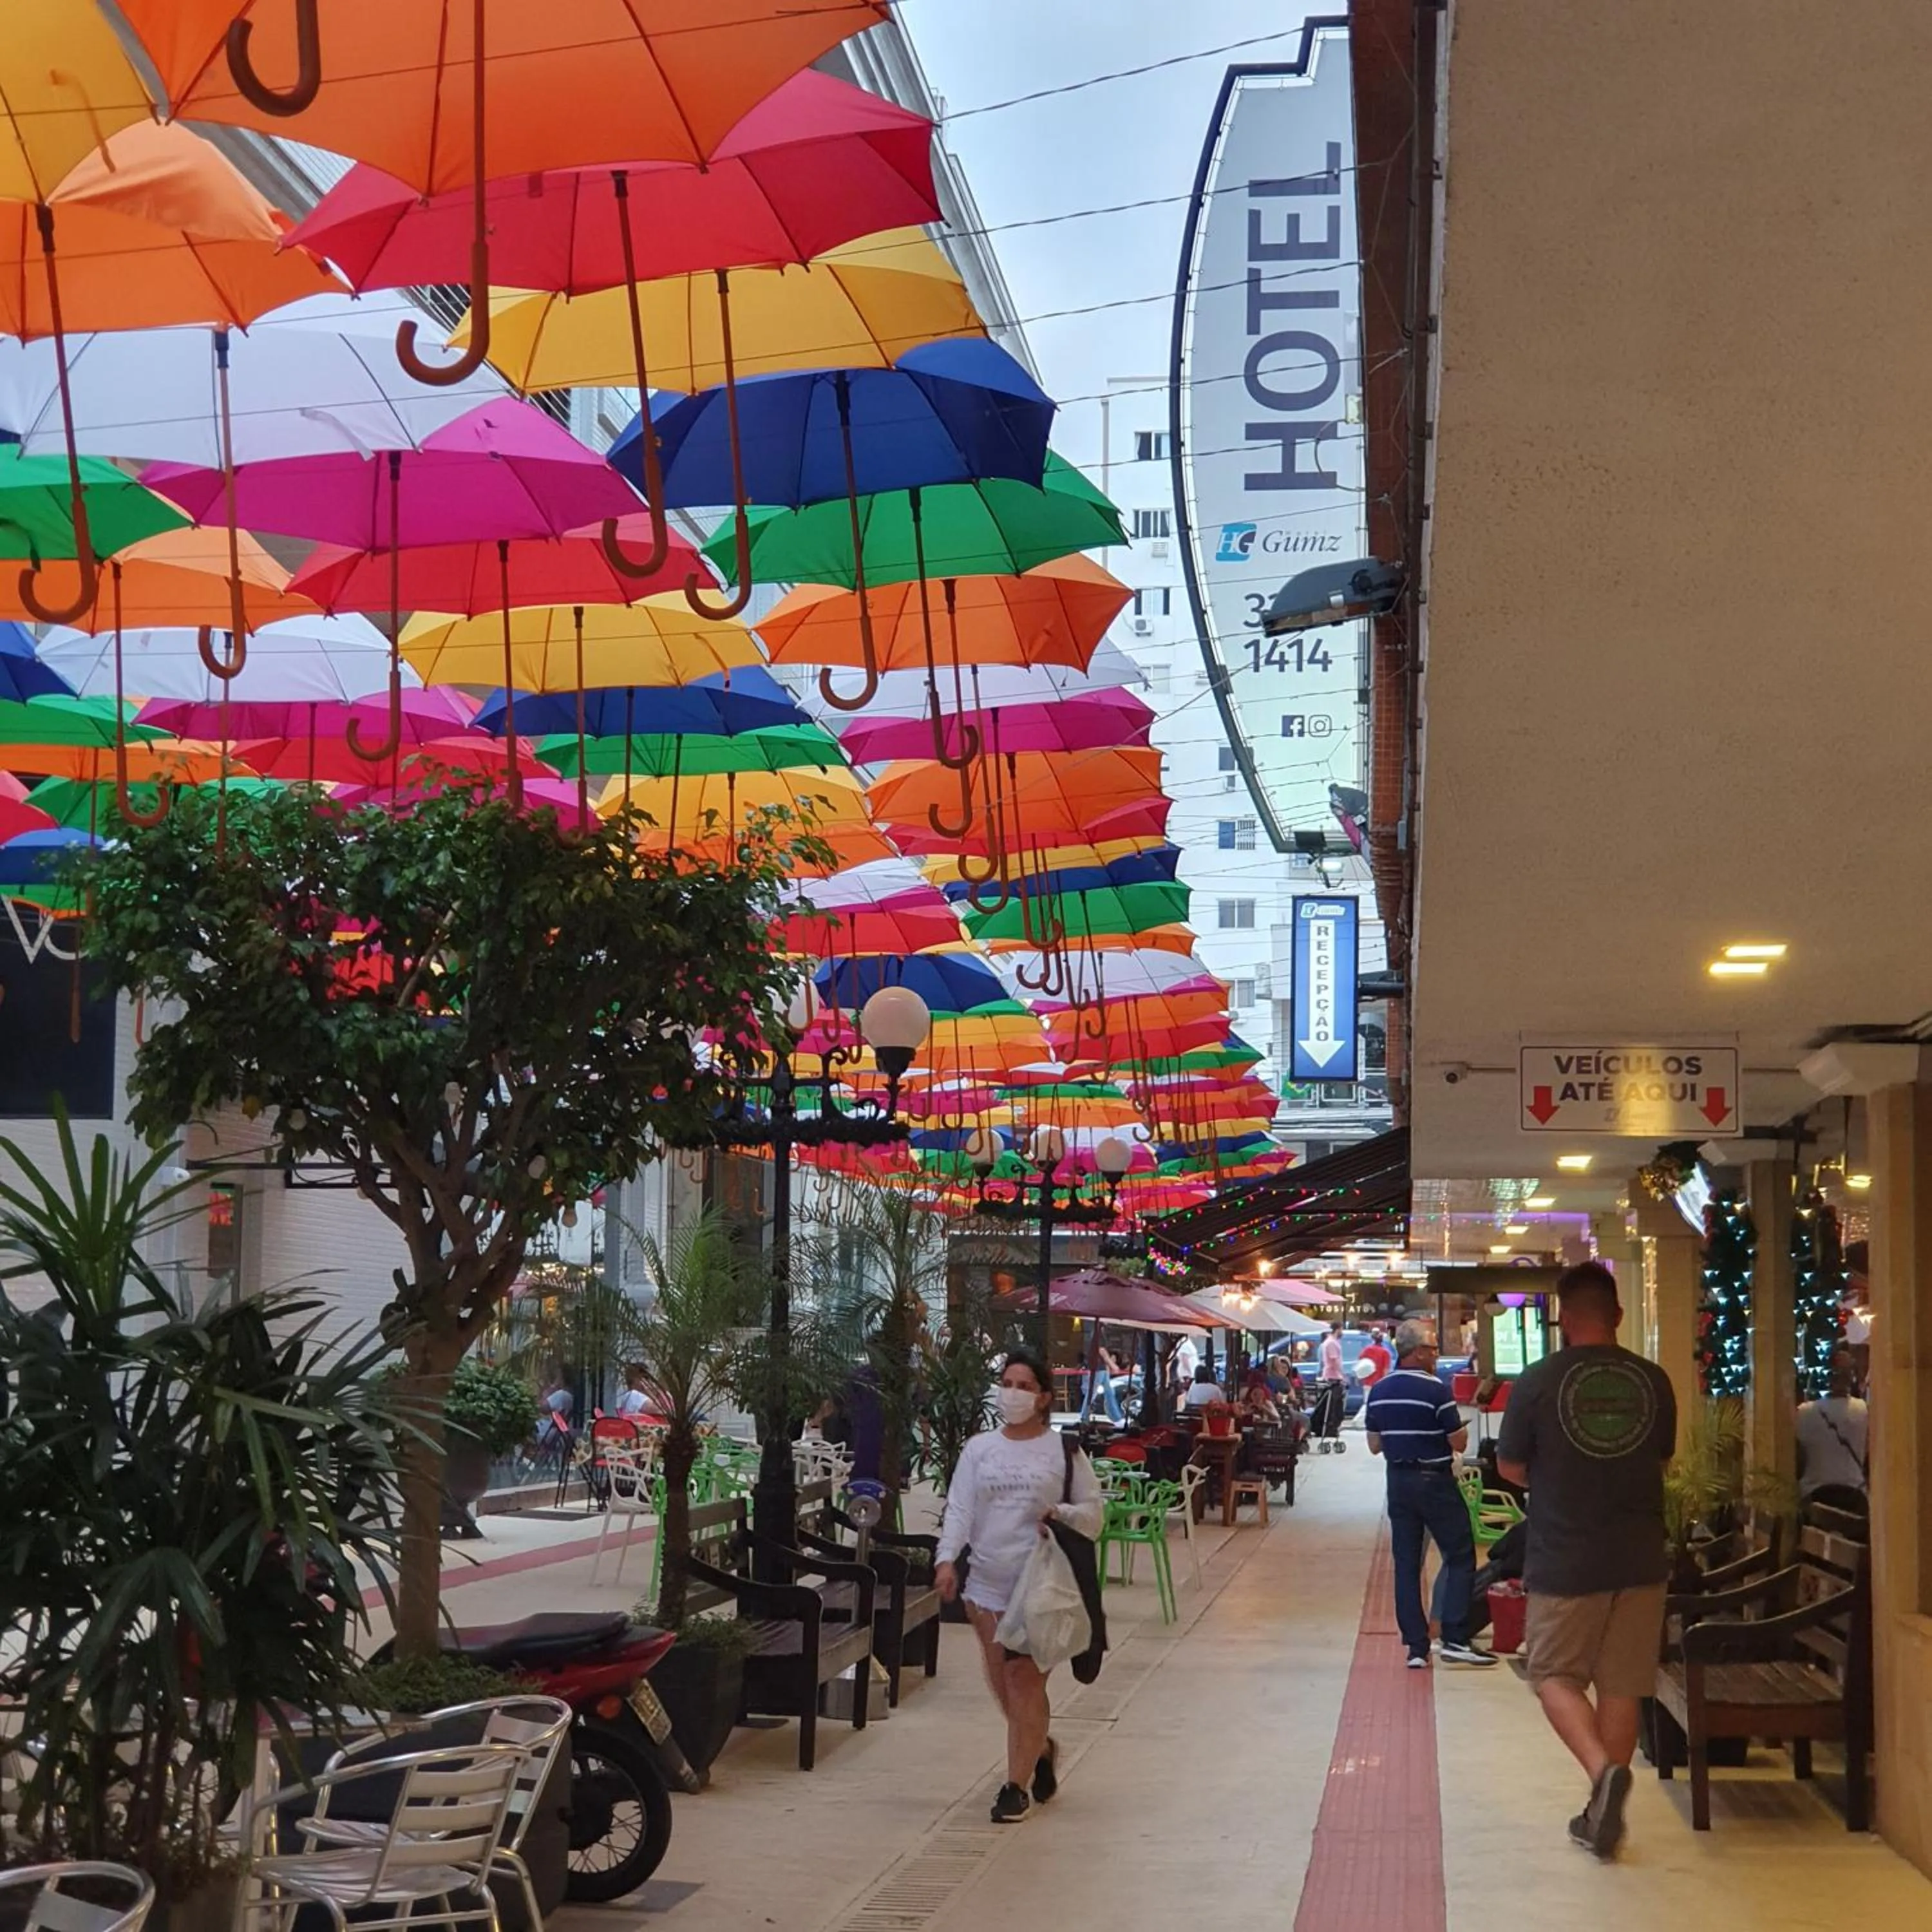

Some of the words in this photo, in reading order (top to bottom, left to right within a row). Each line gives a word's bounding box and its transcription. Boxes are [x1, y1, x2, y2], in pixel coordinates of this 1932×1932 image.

[1244, 142, 1341, 490] HOTEL
[1244, 638, 1332, 672] 1414
[1554, 1051, 1702, 1075] VEÍCULOS
[1559, 1078, 1614, 1101] ATÉ
[1626, 1083, 1697, 1102] AQUI
